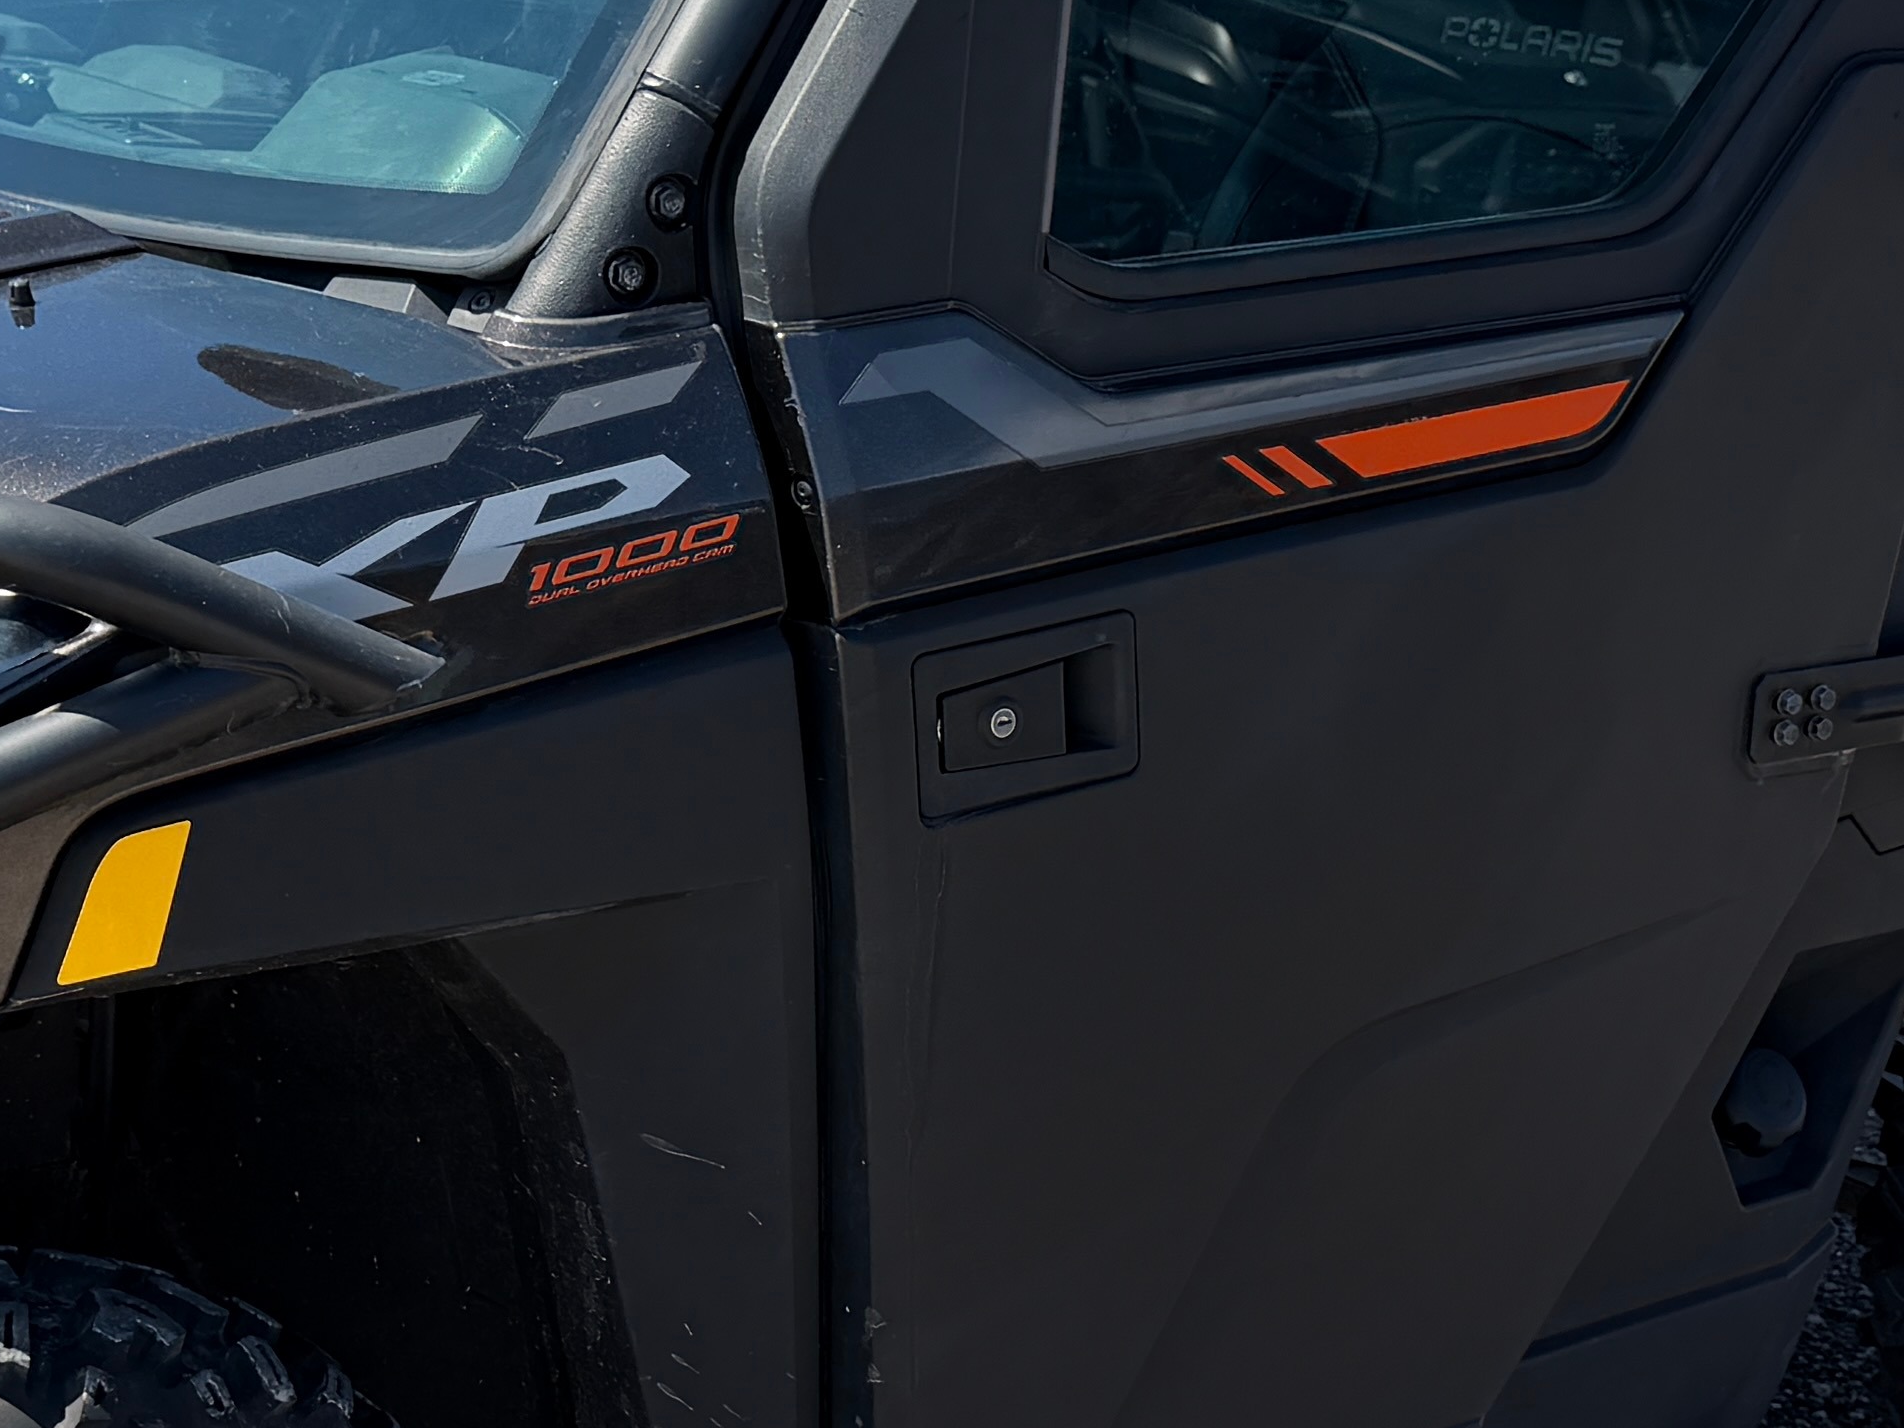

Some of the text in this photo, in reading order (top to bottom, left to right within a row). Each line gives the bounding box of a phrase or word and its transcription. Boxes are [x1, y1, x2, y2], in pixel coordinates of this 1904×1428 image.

[1440, 16, 1624, 68] POLARIS
[220, 453, 691, 622] XP
[528, 513, 742, 591] 1000
[527, 543, 736, 607] DUAL OVERHEAD CAM
